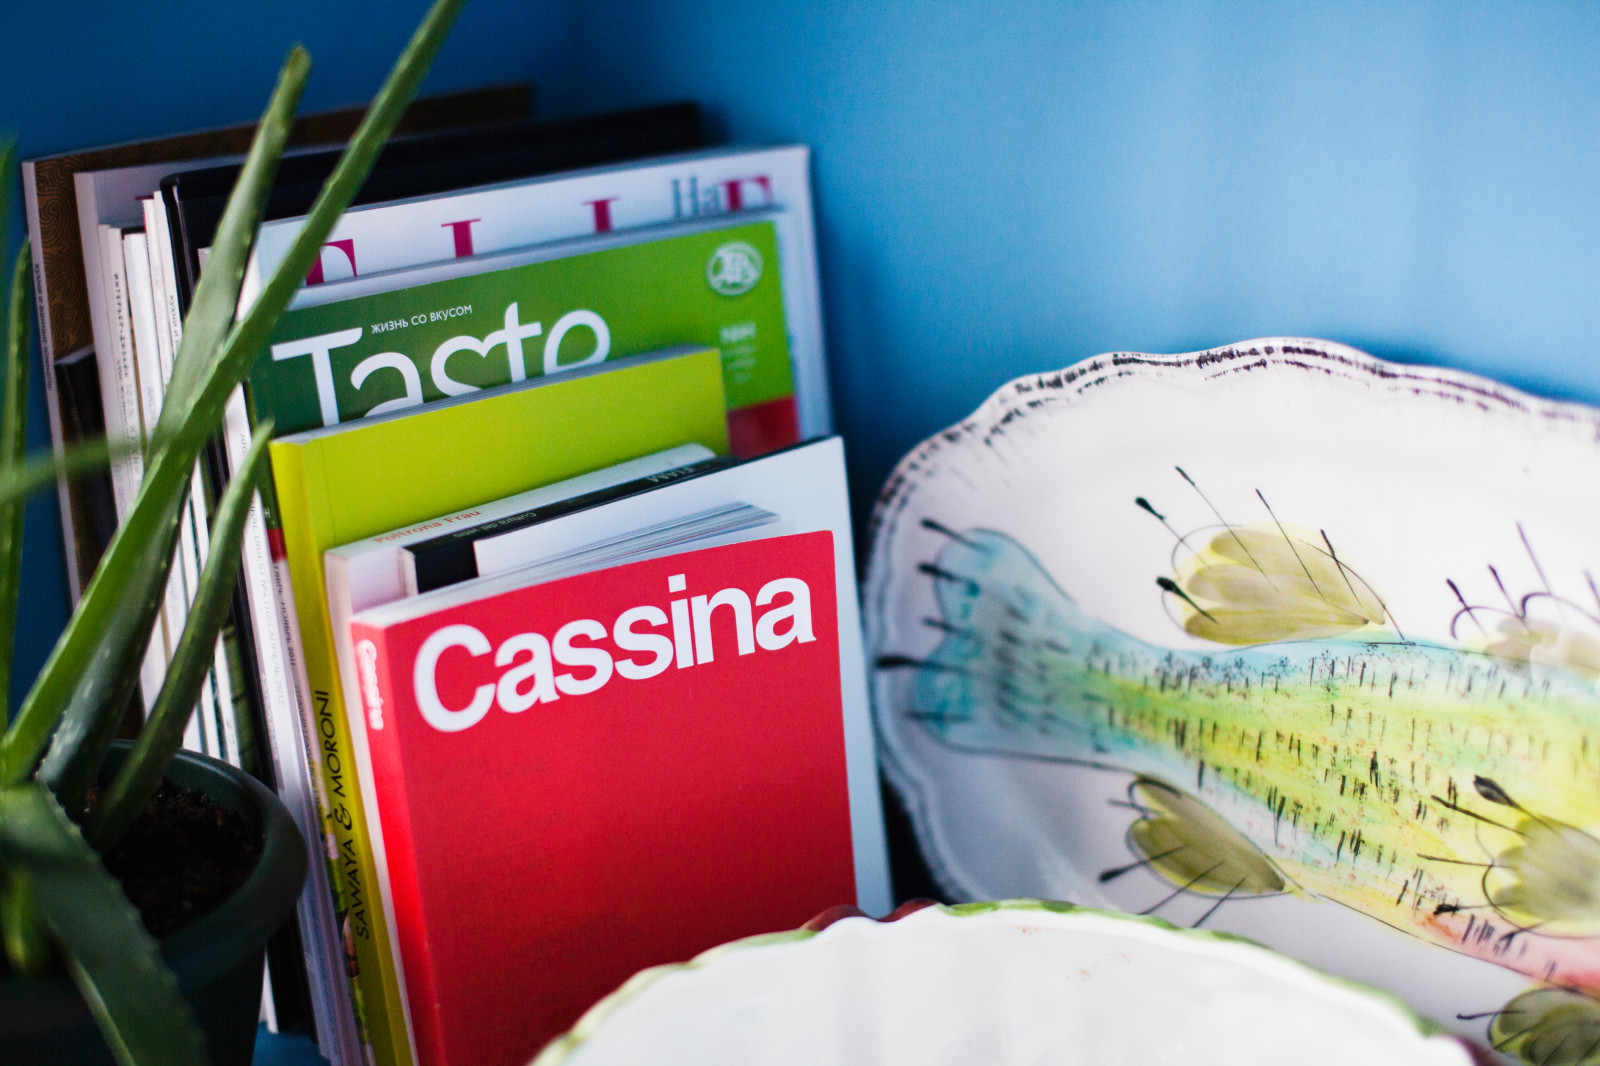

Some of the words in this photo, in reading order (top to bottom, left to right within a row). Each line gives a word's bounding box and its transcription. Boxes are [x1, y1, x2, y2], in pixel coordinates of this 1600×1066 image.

[271, 302, 611, 427] Taste
[371, 319, 409, 335] ЖИЗНЬ
[411, 314, 428, 326] СО
[430, 304, 473, 322] ВКУСОМ
[372, 522, 442, 543] Poltrona
[443, 510, 482, 527] Frau
[414, 573, 817, 733] Cassina
[314, 690, 346, 798] MORONI
[334, 802, 353, 831] &
[342, 839, 369, 940] SAWAYA
